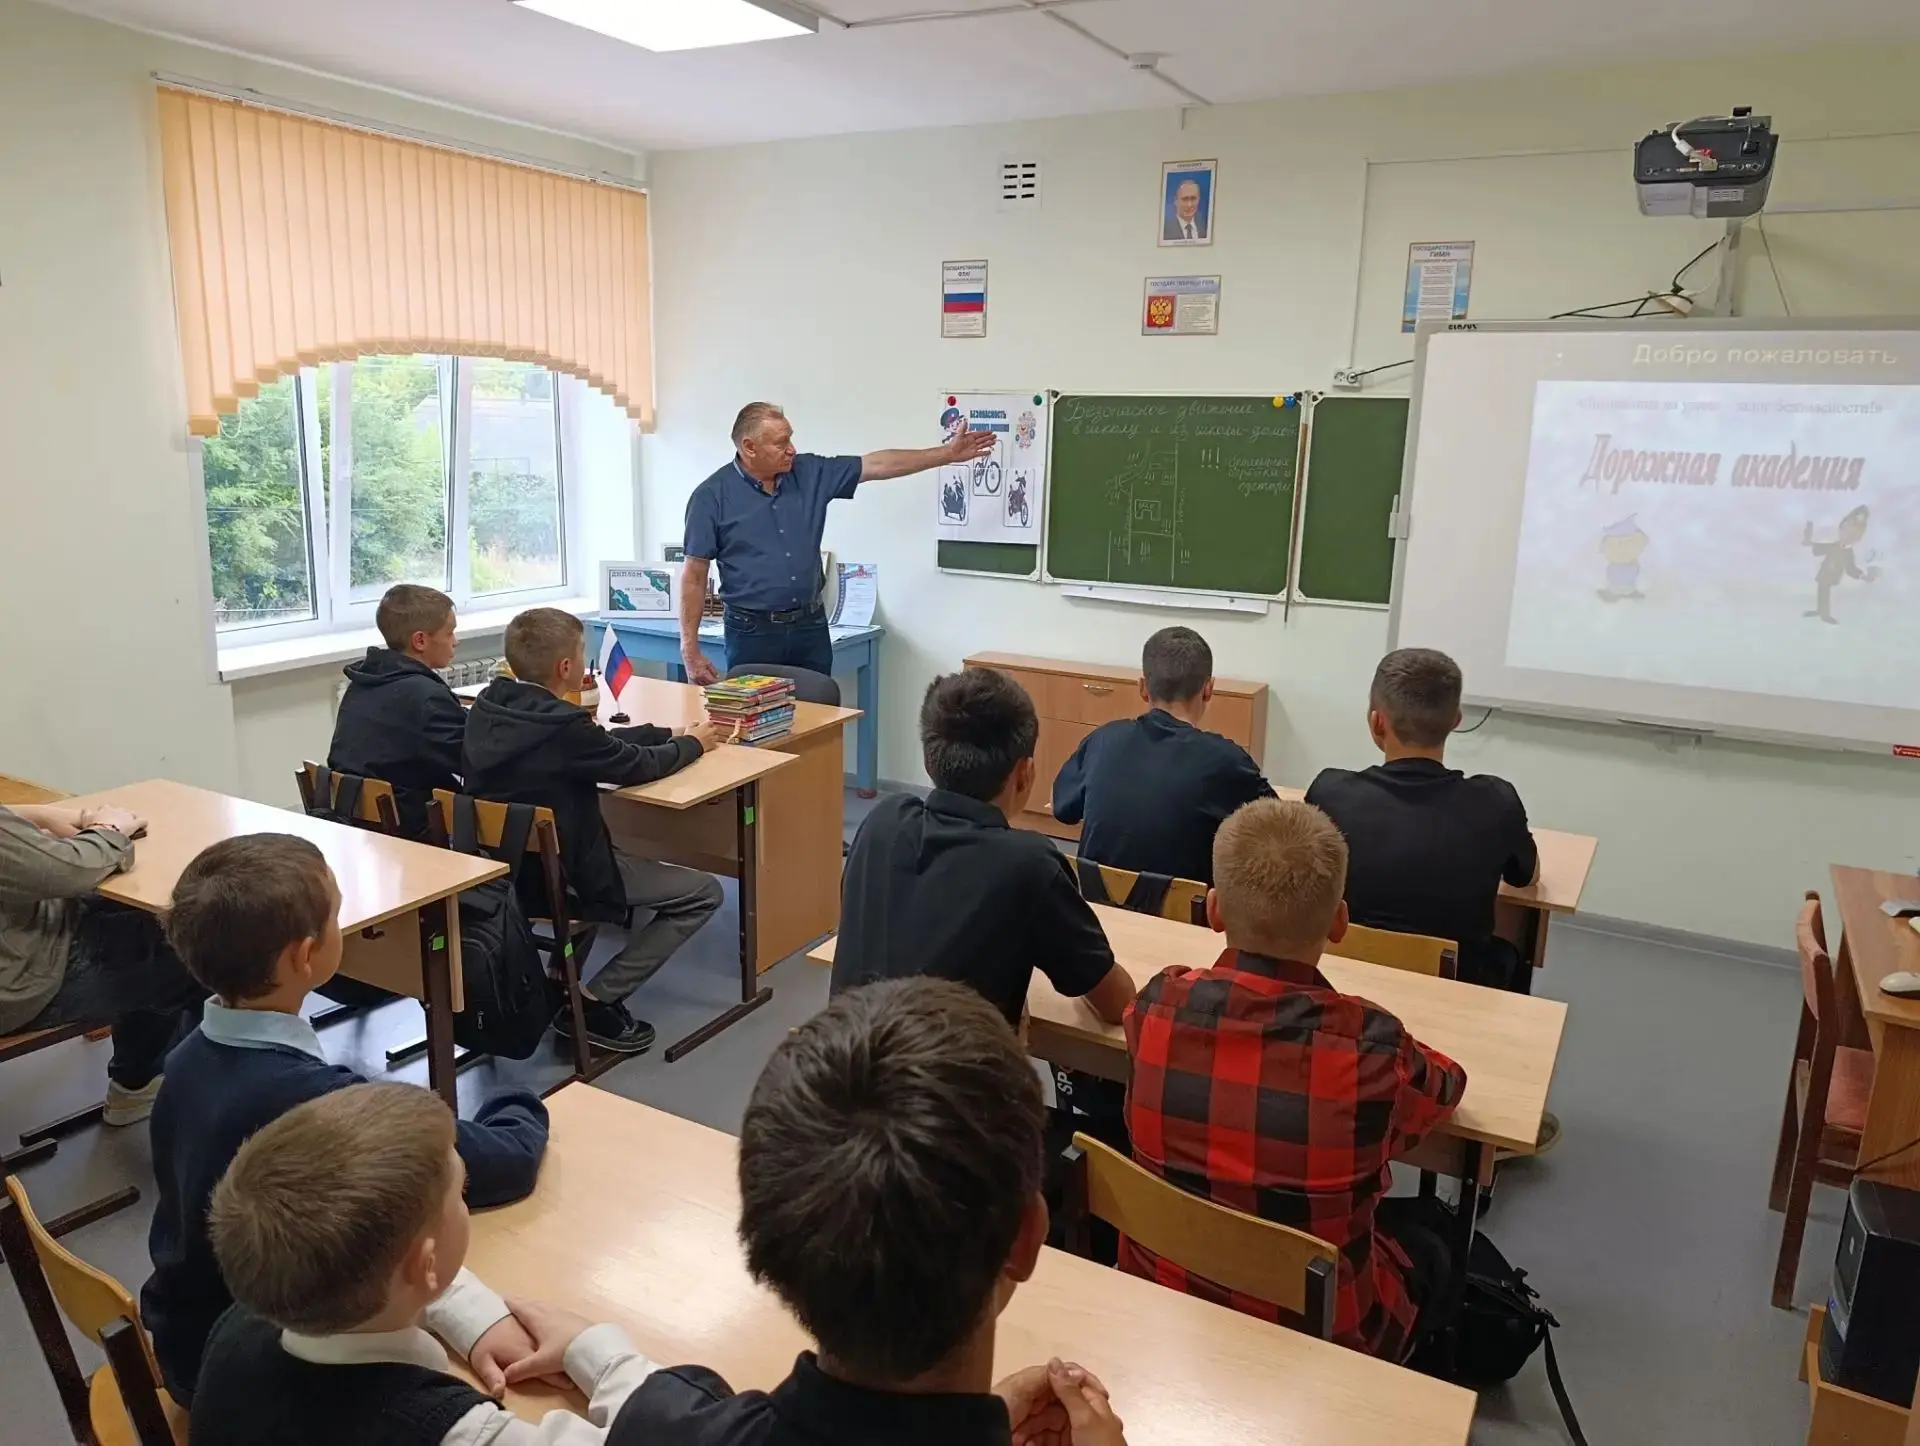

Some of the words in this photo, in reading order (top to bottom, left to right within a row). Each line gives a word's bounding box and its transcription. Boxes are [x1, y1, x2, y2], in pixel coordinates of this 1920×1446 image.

[1632, 344, 1717, 369] Добро
[1727, 348, 1898, 365] пожаловать
[1578, 433, 1722, 495] Дорожная
[1731, 439, 1866, 491] академия
